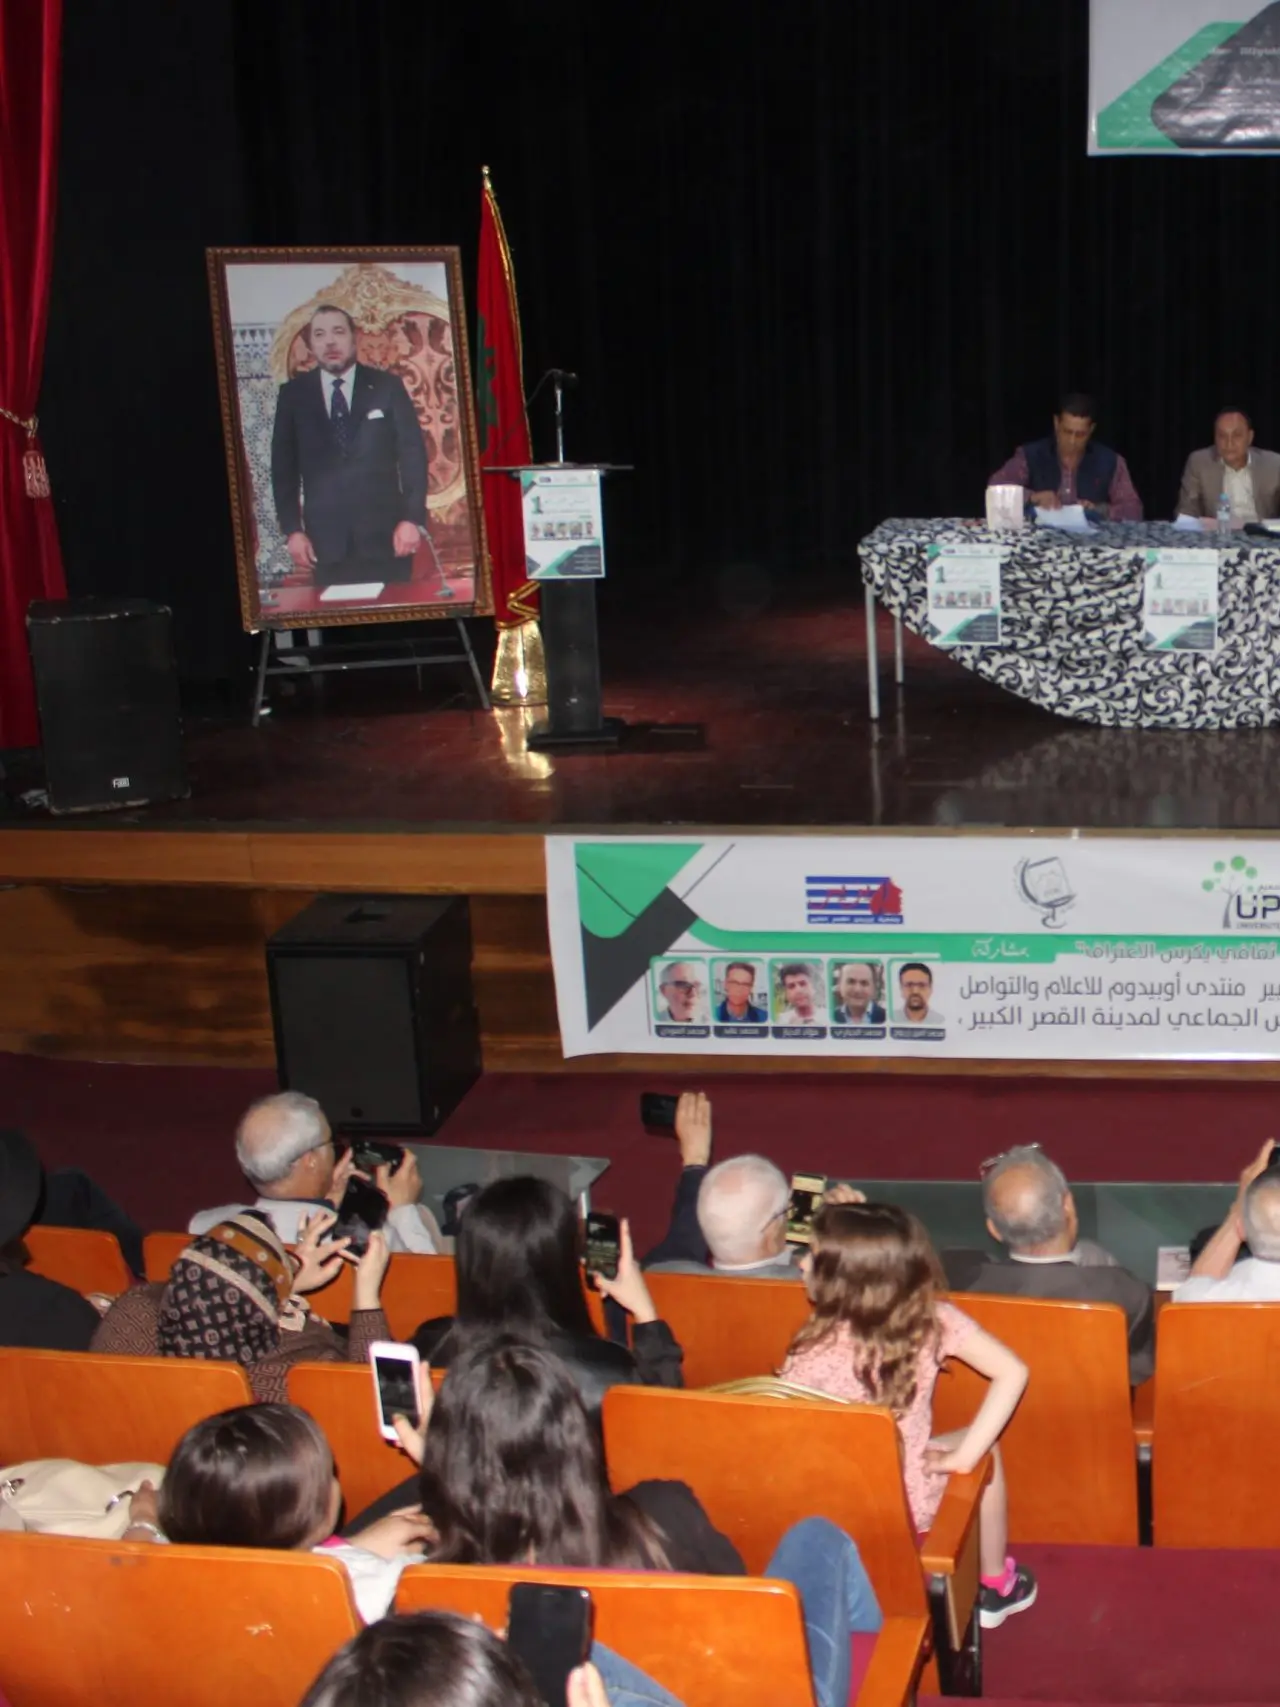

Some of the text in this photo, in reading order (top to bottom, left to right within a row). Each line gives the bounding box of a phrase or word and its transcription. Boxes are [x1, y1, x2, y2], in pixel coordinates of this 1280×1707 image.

[1161, 943, 1210, 964] يكرس
[960, 975, 1039, 1001] والتواصل
[1044, 976, 1102, 1001] للاعلام
[1108, 971, 1181, 1002] أوبيدوم
[1186, 977, 1246, 996] منتدى
[968, 1006, 1021, 1031] الكبير
[1028, 1006, 1086, 1031] القصر
[1092, 1006, 1160, 1031] لمدينة
[1167, 1007, 1258, 1031] الجماعي
